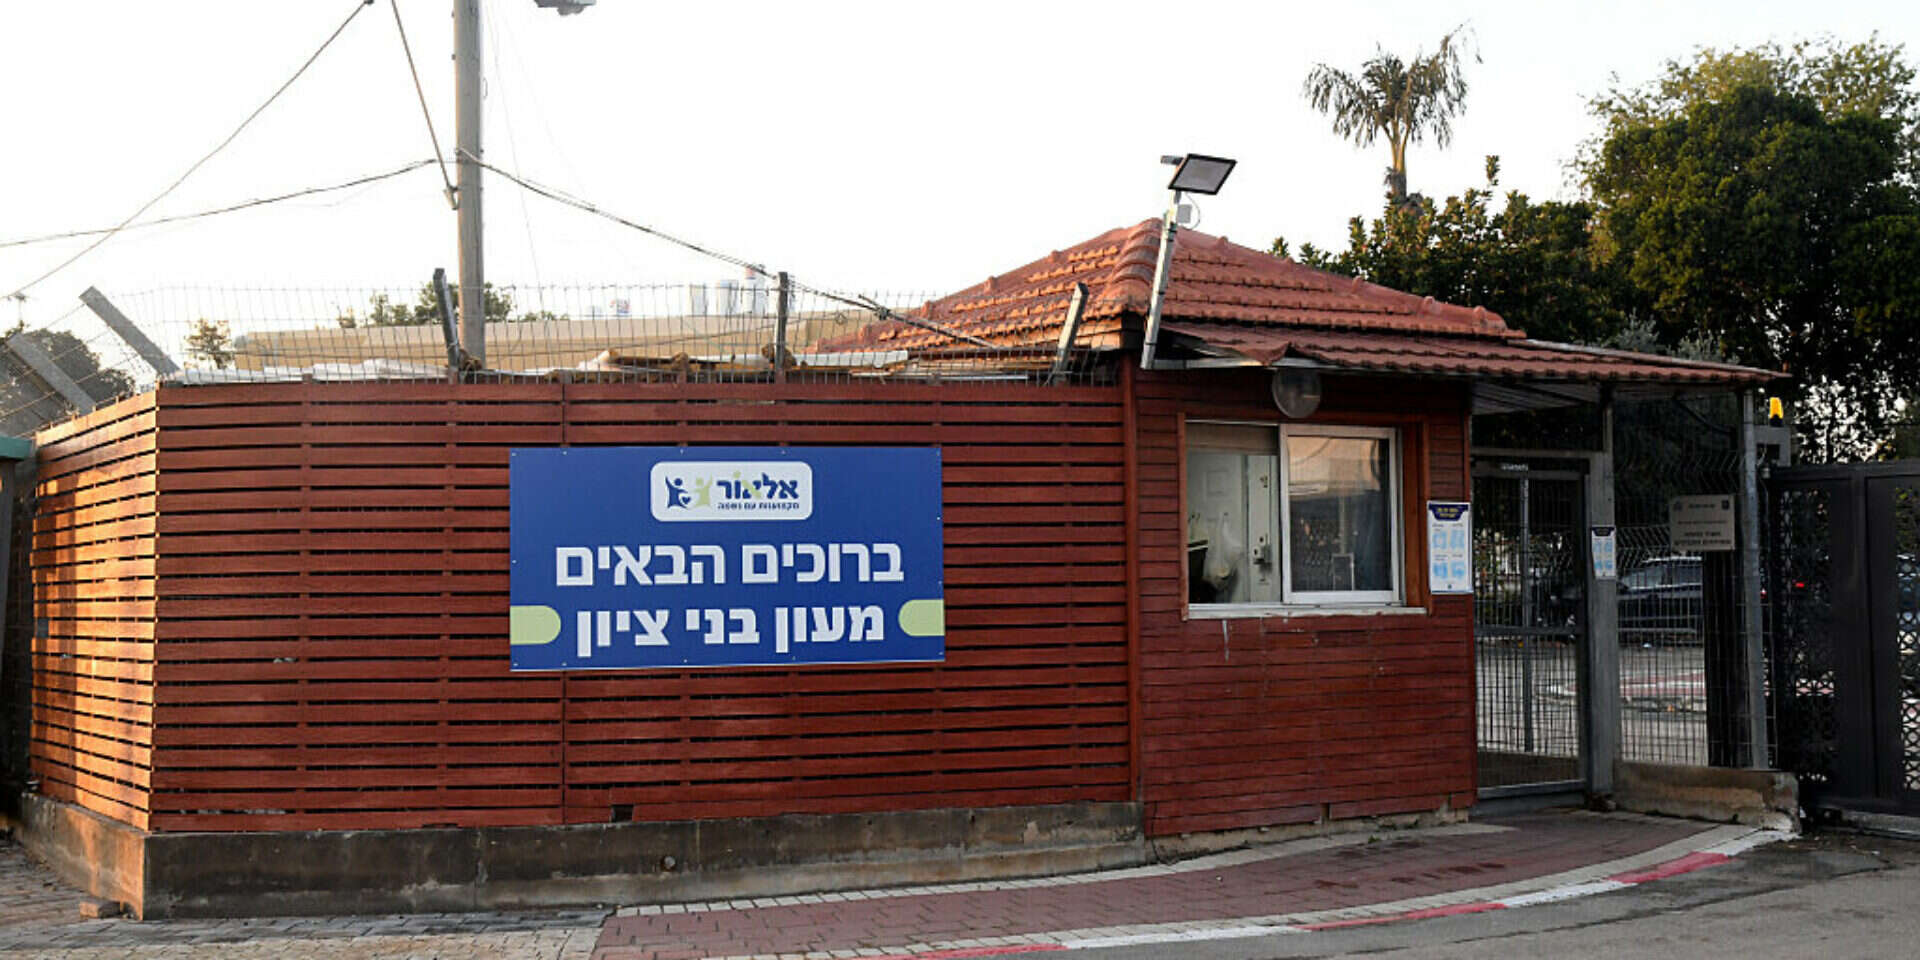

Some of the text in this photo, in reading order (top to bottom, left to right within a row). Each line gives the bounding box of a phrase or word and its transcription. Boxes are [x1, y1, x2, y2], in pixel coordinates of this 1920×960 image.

[556, 543, 904, 586] ברוכים הבאים
[577, 604, 885, 658] מעון בני ציון
